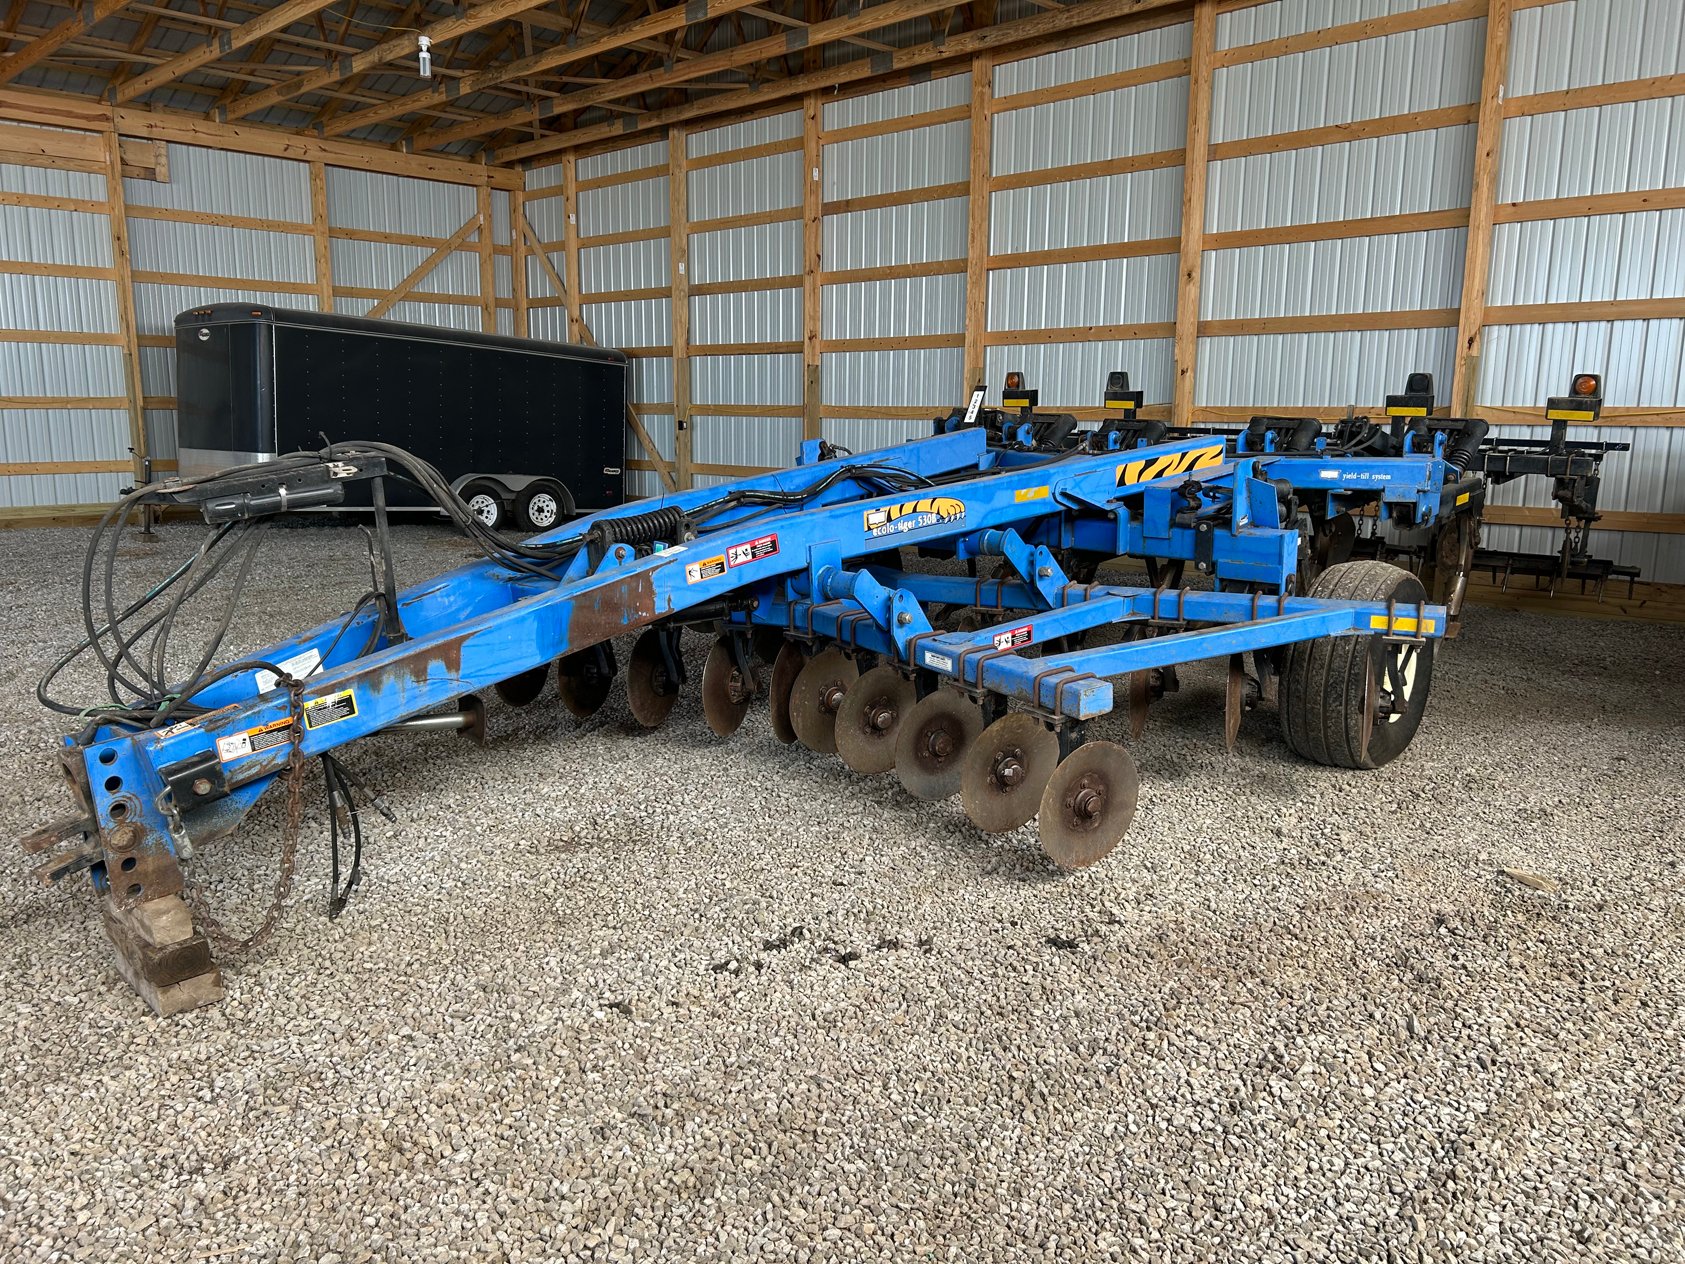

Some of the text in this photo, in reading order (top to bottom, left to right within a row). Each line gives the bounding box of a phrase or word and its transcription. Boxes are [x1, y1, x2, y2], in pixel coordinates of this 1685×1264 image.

[1342, 472, 1369, 481] yield-till
[872, 520, 915, 536] ecolo-tiger
[264, 720, 290, 730] WARNING
